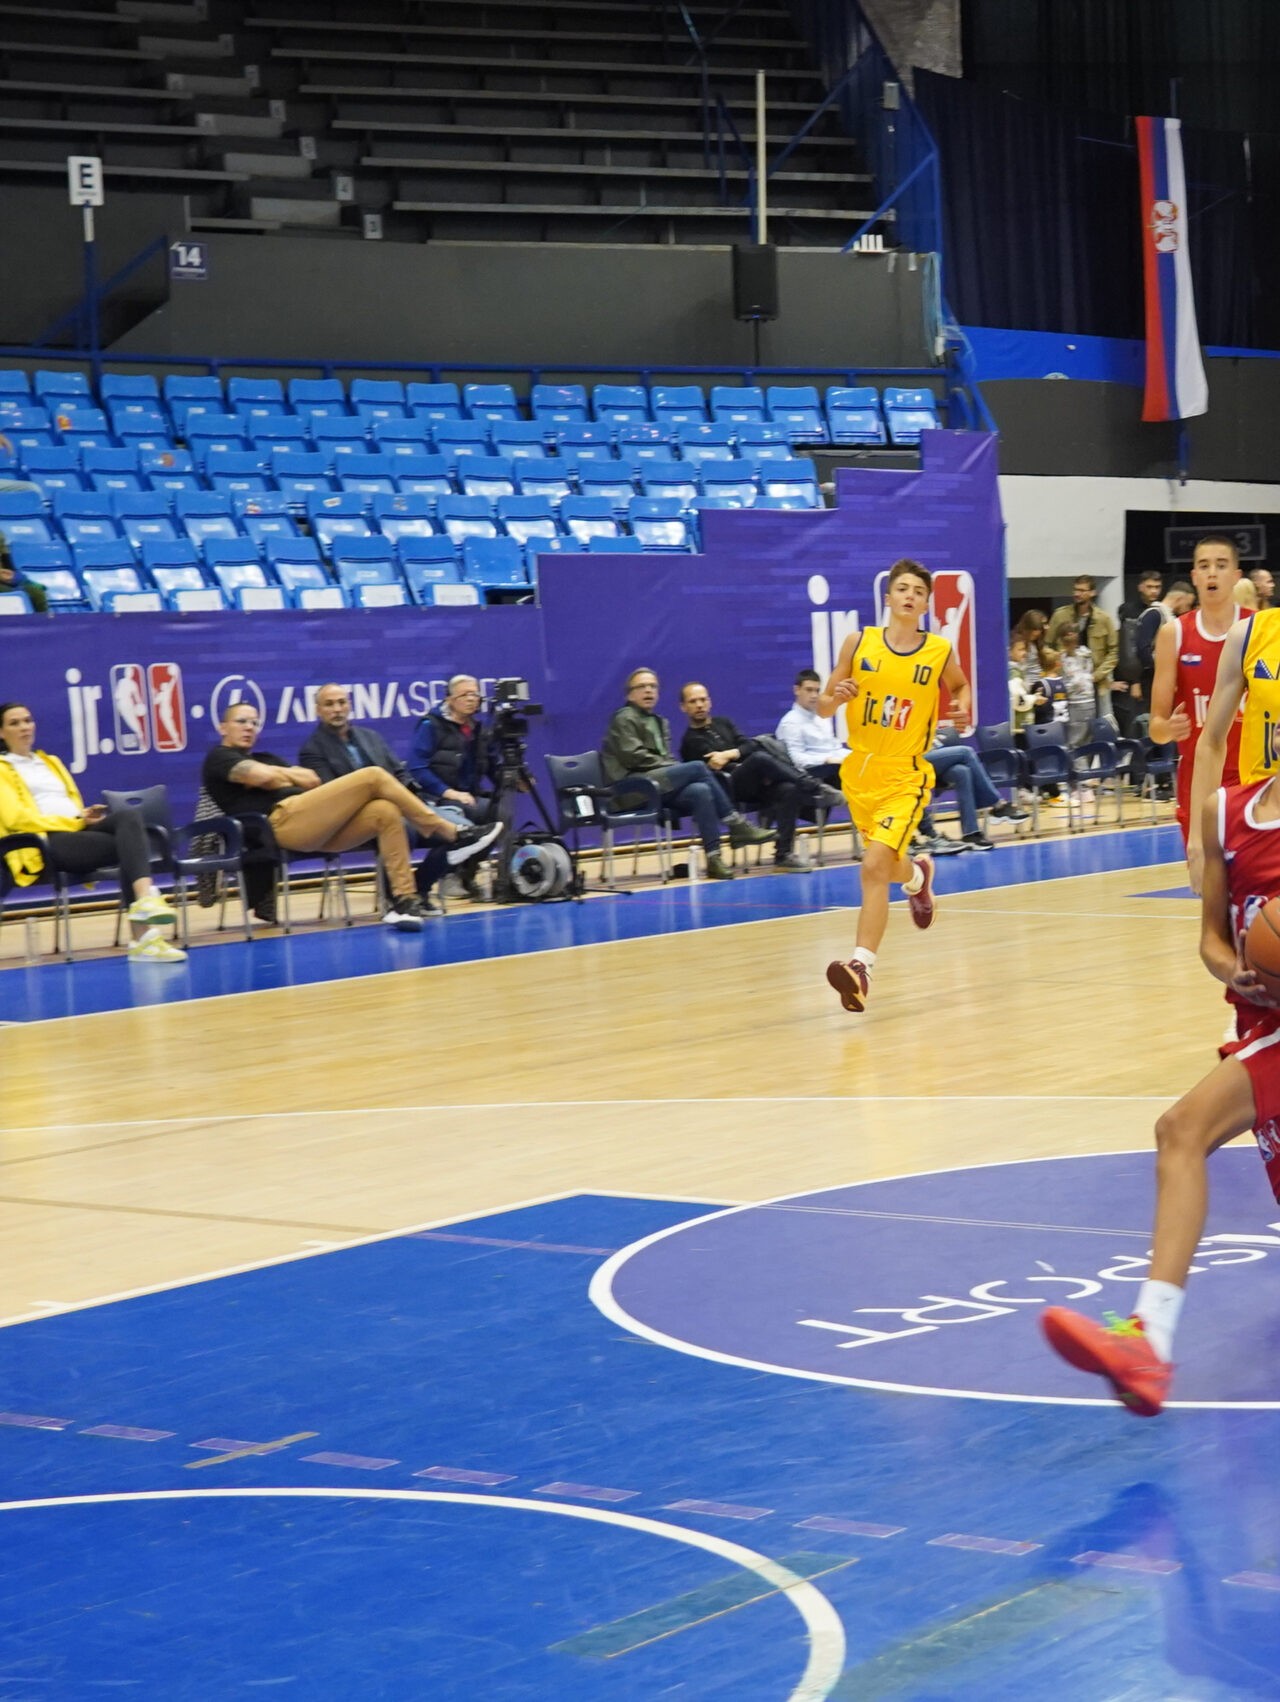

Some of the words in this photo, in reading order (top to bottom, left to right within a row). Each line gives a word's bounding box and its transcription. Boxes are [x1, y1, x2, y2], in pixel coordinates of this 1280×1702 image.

[80, 163, 94, 189] E
[176, 246, 202, 266] 14
[913, 664, 932, 686] 10
